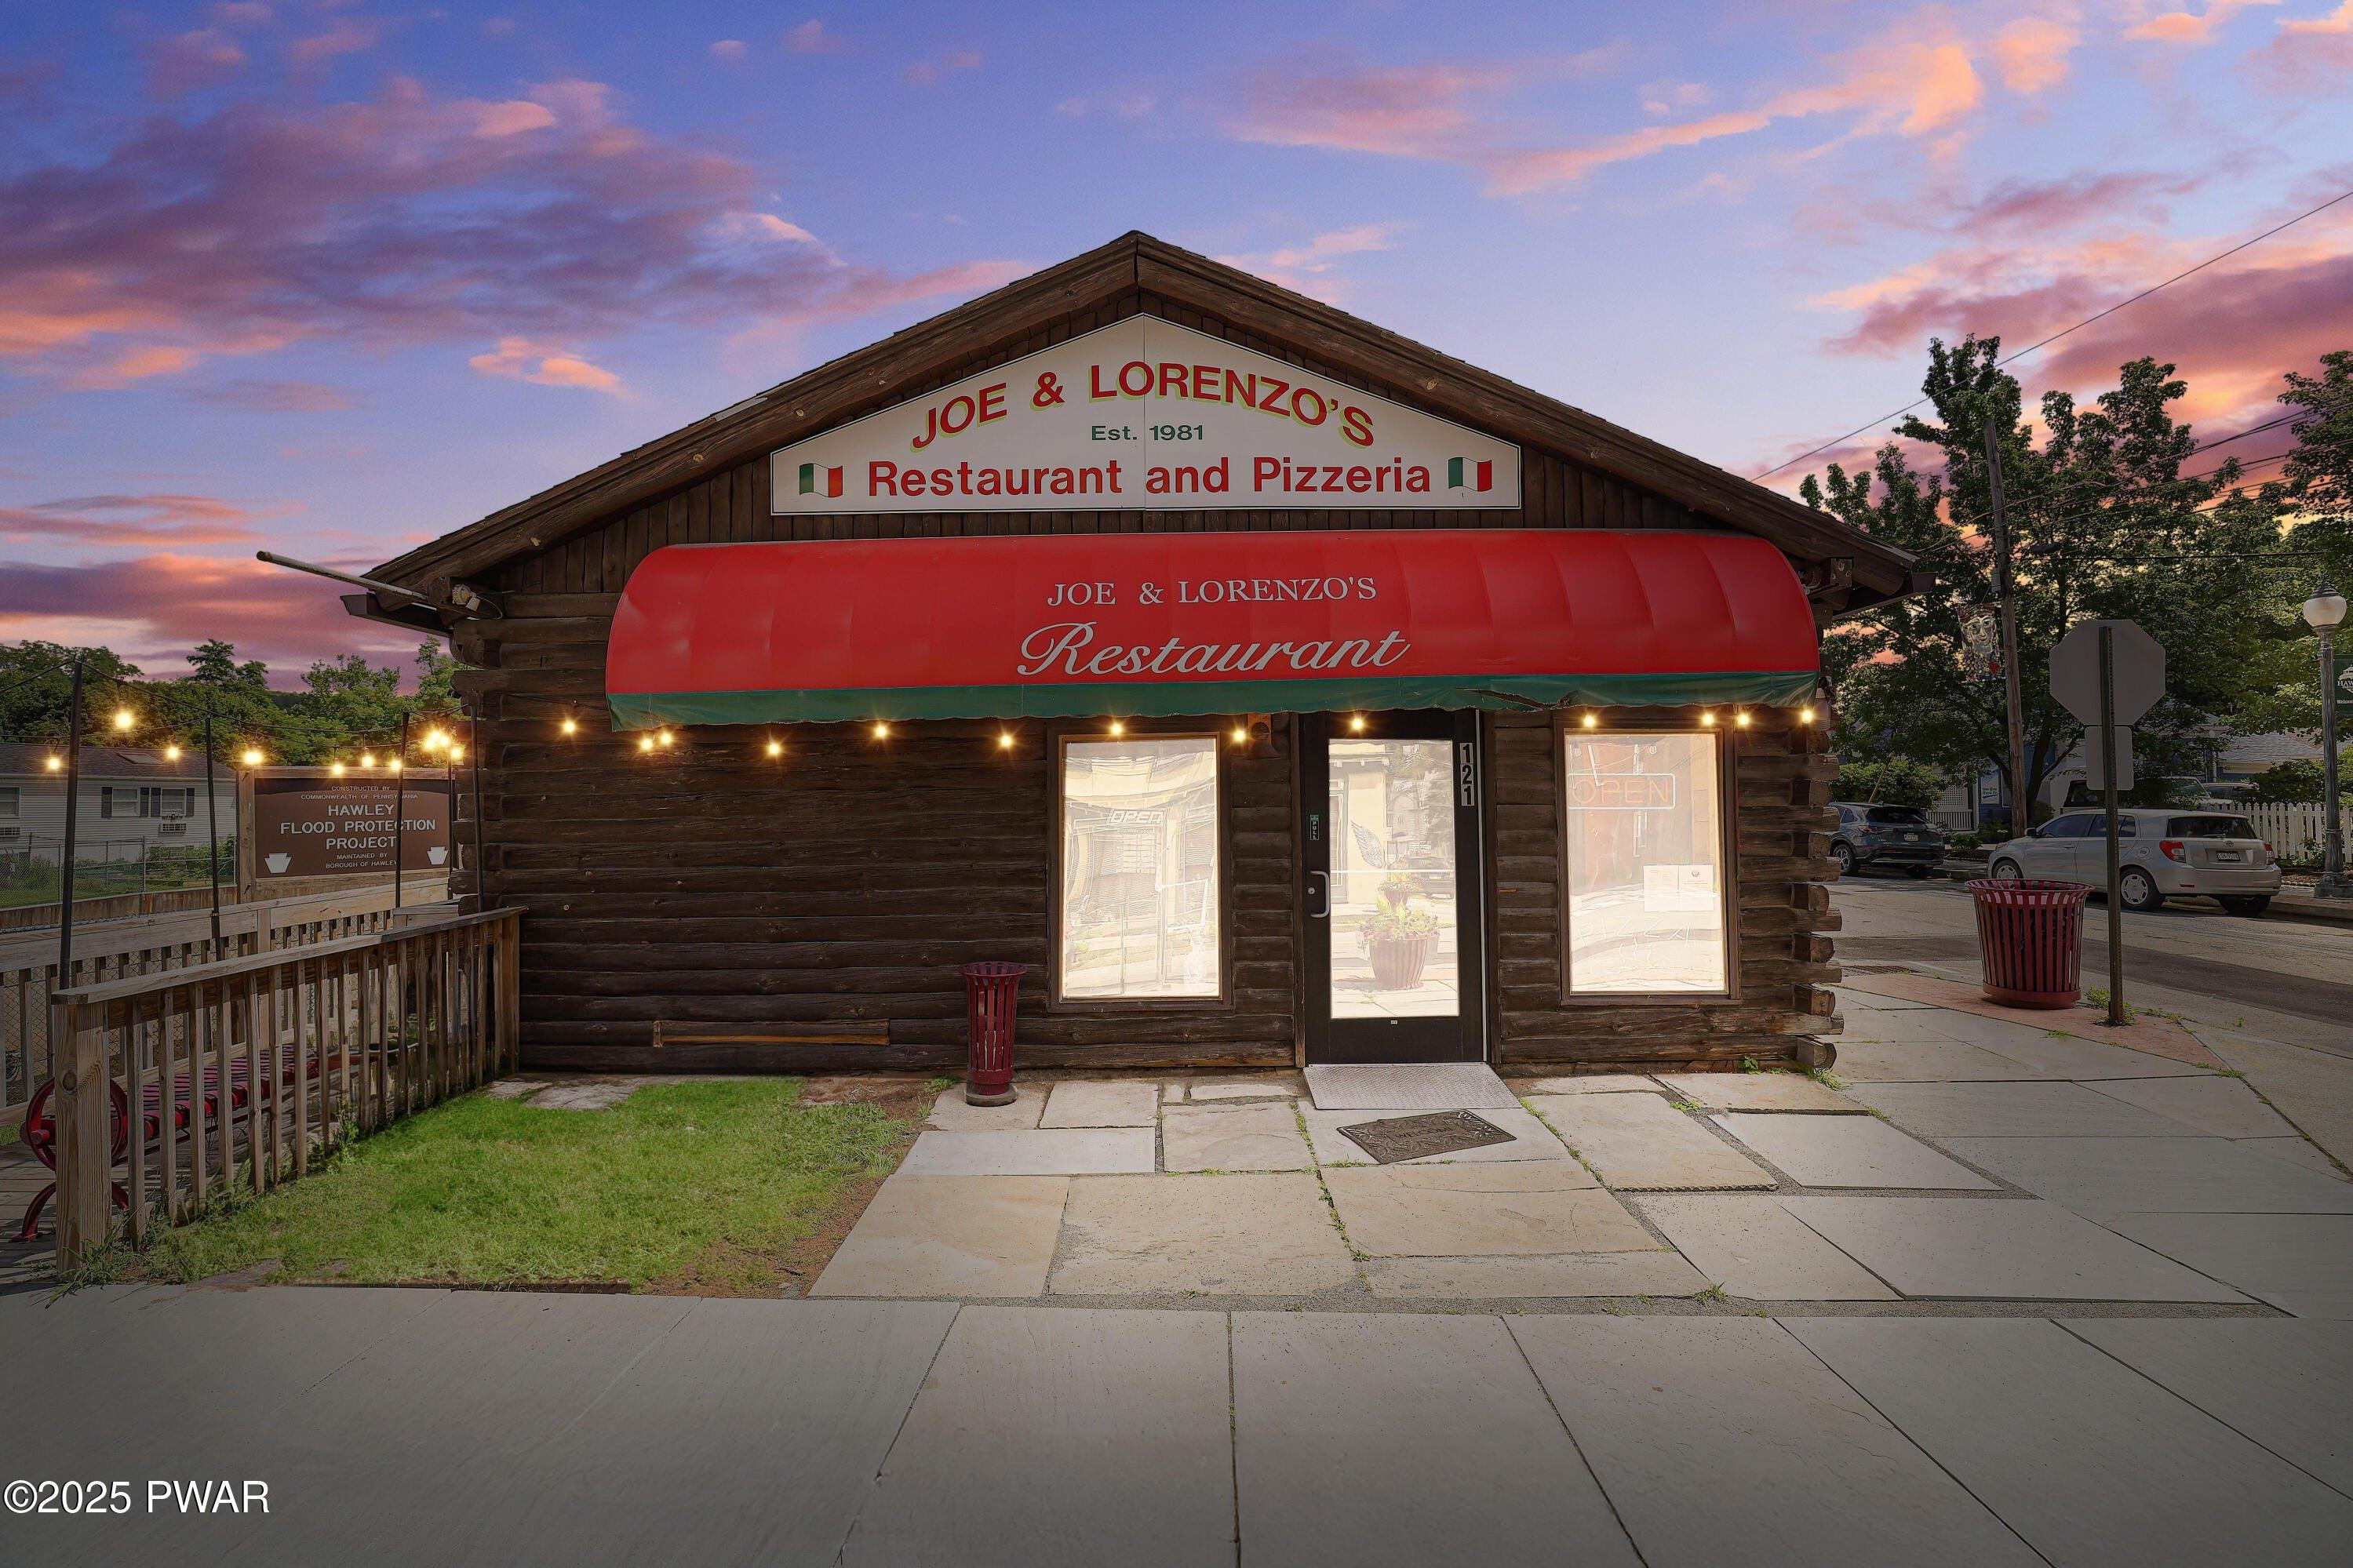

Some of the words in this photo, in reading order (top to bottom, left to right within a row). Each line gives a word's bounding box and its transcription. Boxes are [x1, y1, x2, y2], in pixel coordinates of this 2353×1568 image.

[911, 382, 1007, 452] JOE
[1031, 371, 1065, 412] &
[1090, 360, 1375, 449] LORENZO'S
[1091, 426, 1137, 441] Est.
[1149, 424, 1204, 441] 1981
[869, 460, 1123, 497] Restaurant
[1146, 457, 1230, 493] and
[1254, 457, 1432, 493] Pizzeria
[1047, 582, 1116, 607] JOE
[1138, 582, 1165, 604] &
[1178, 577, 1378, 603] LORENZO'S
[1017, 620, 1412, 676] Restaurant
[1572, 779, 1669, 804] OPEN
[328, 803, 395, 817] HAWLEY
[280, 821, 336, 835] FLOOD
[326, 835, 397, 849] PROJECT
[1576, 915, 1690, 946] PIZZA
